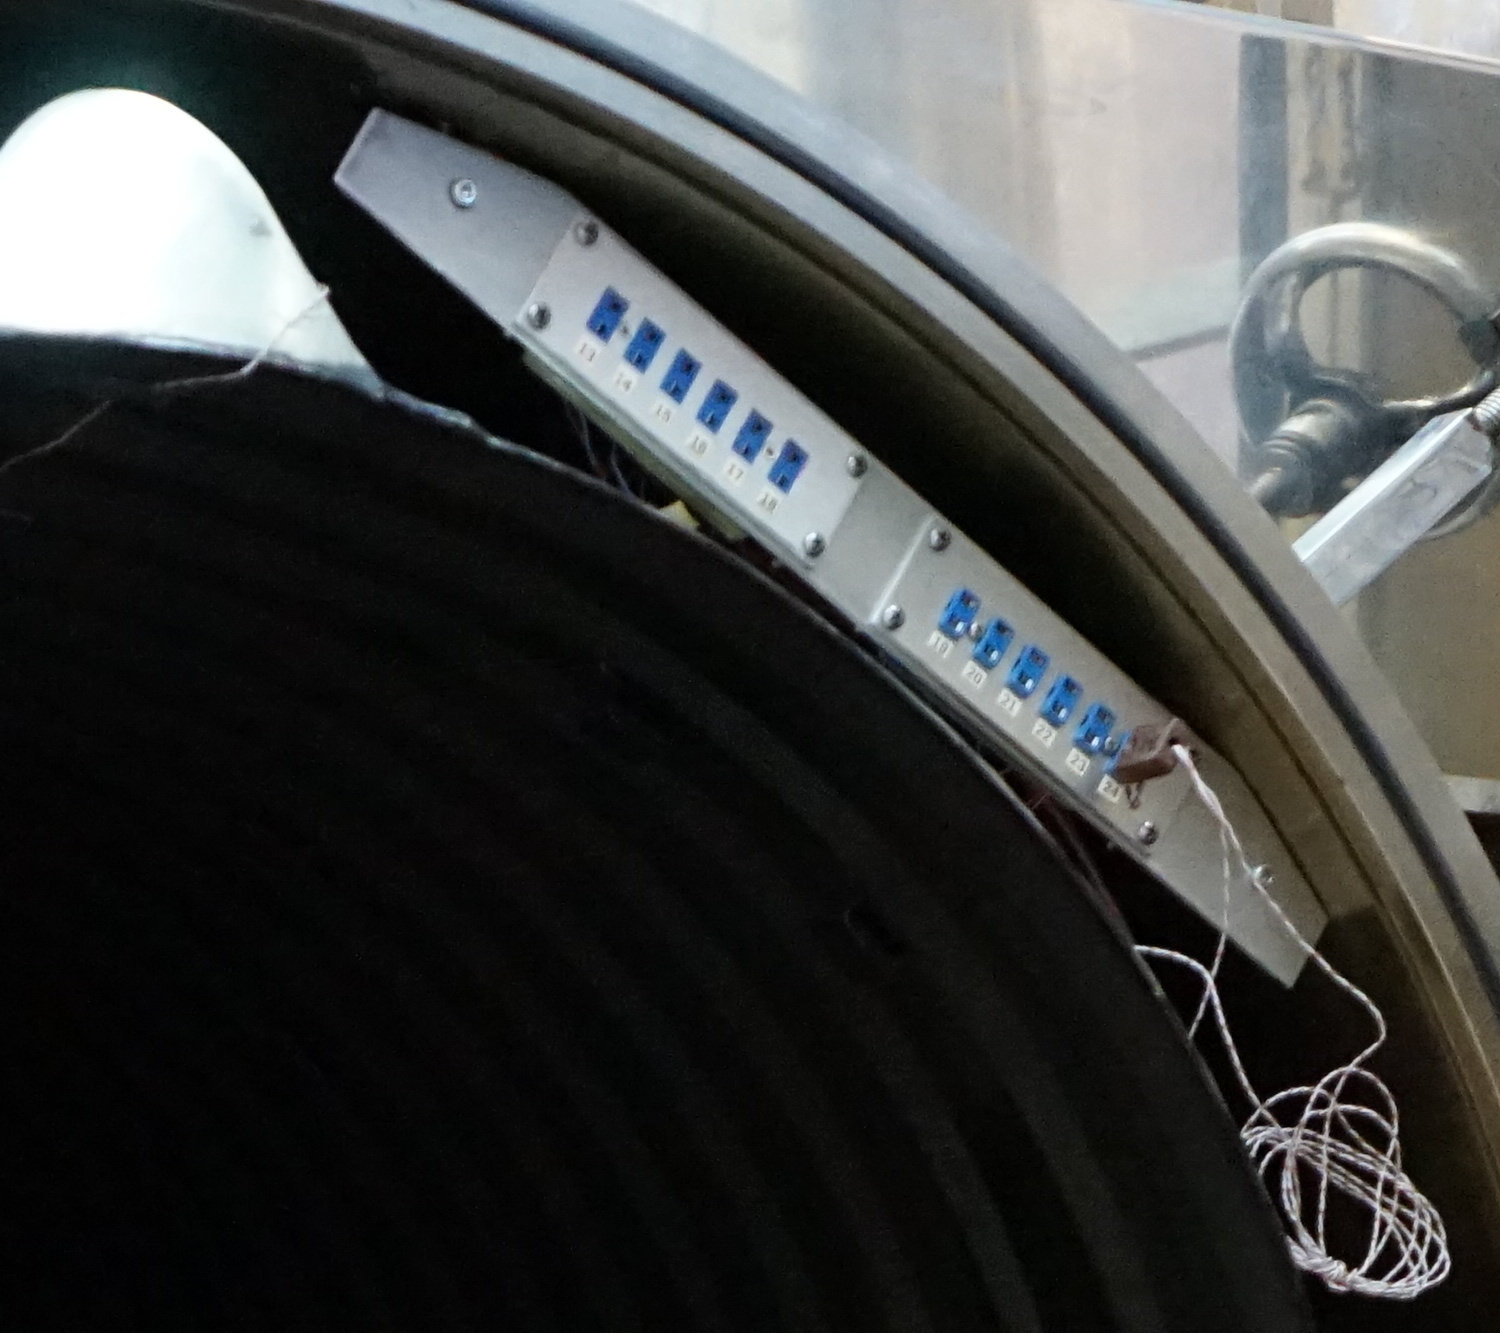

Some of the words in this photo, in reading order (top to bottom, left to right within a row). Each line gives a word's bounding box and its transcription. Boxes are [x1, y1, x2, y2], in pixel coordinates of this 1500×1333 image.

[728, 463, 744, 480] 17
[932, 637, 950, 653] 19
[966, 668, 984, 685] 20
[1001, 693, 1017, 711] 21
[1035, 725, 1053, 740] 22
[1070, 757, 1087, 773] 23
[1102, 780, 1120, 798] 24
